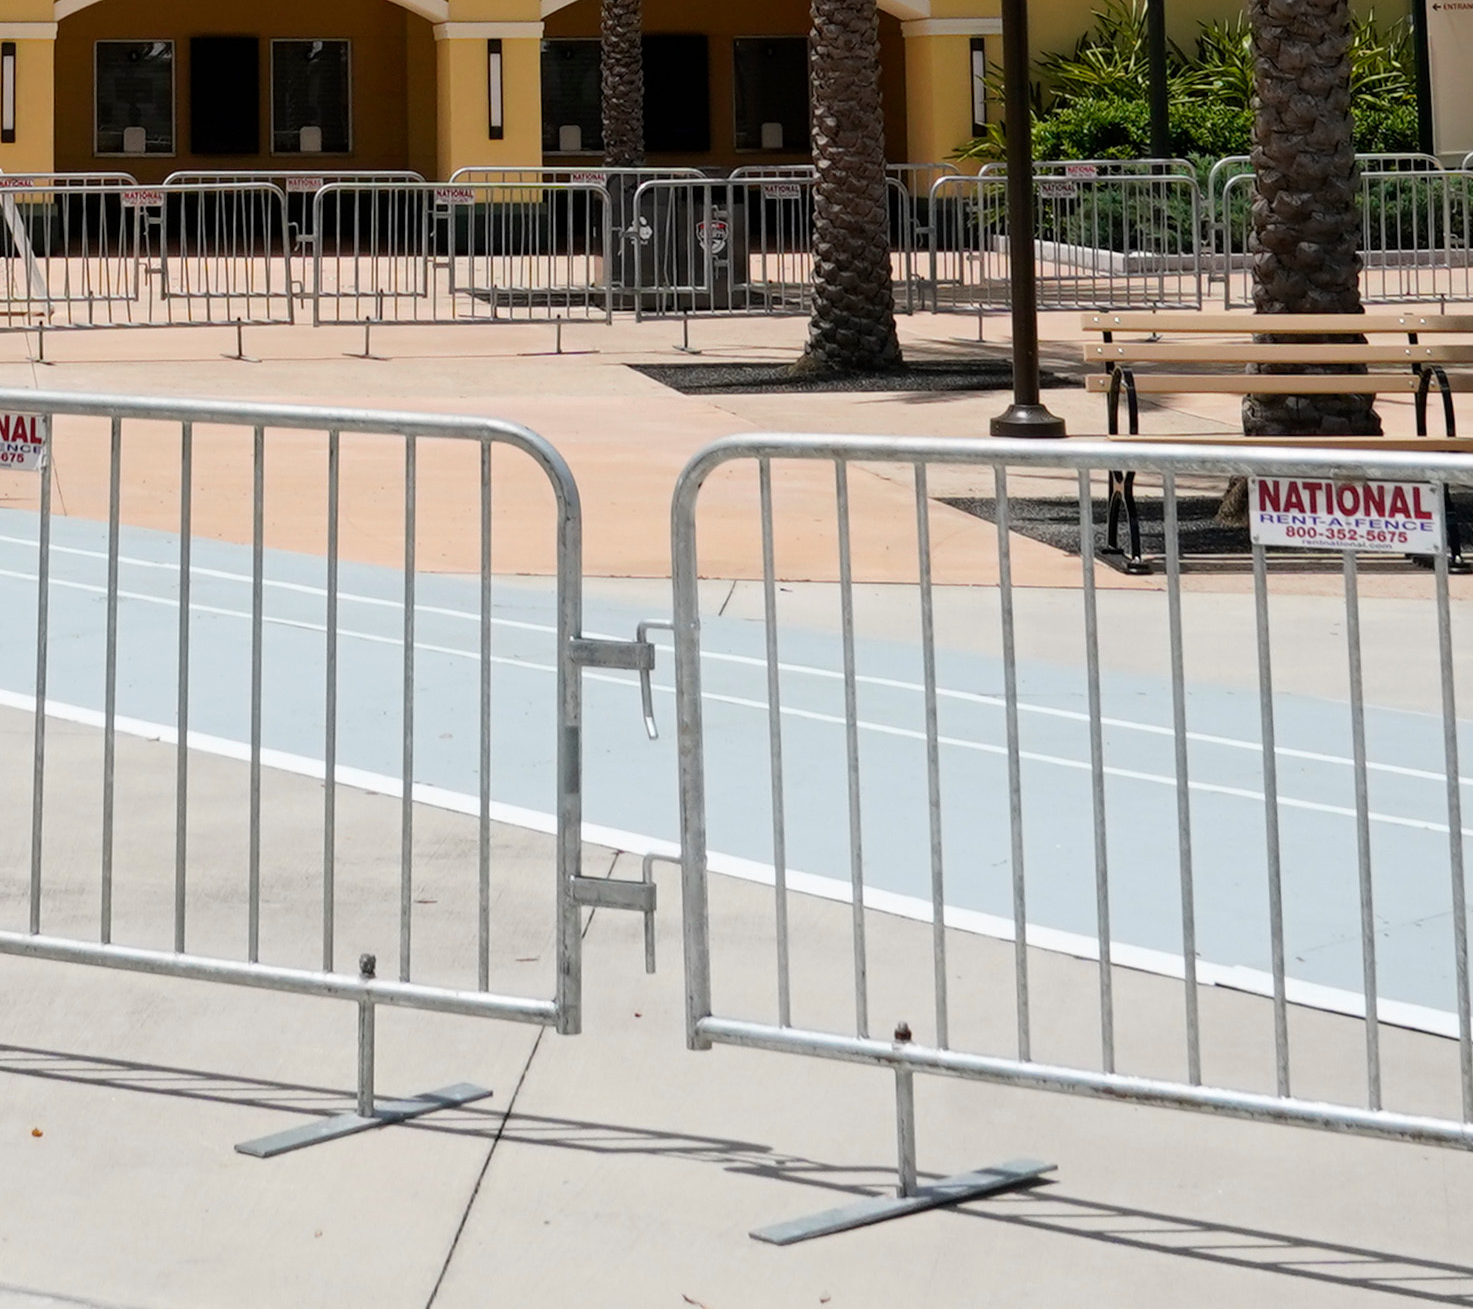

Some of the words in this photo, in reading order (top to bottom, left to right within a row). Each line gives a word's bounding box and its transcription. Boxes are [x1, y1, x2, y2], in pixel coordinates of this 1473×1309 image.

[1067, 166, 1095, 174] NATIONAL
[572, 173, 605, 181] NATIONAL
[436, 187, 474, 198] NATIONAL
[1042, 183, 1075, 192] NATIONAL
[124, 190, 162, 200] NATIONAL
[1258, 479, 1433, 520] NATIONAL
[1259, 513, 1435, 532] RENT-A-FENCE
[1285, 526, 1408, 543] 800-352-5675
[1301, 539, 1393, 550] rentnational.com
